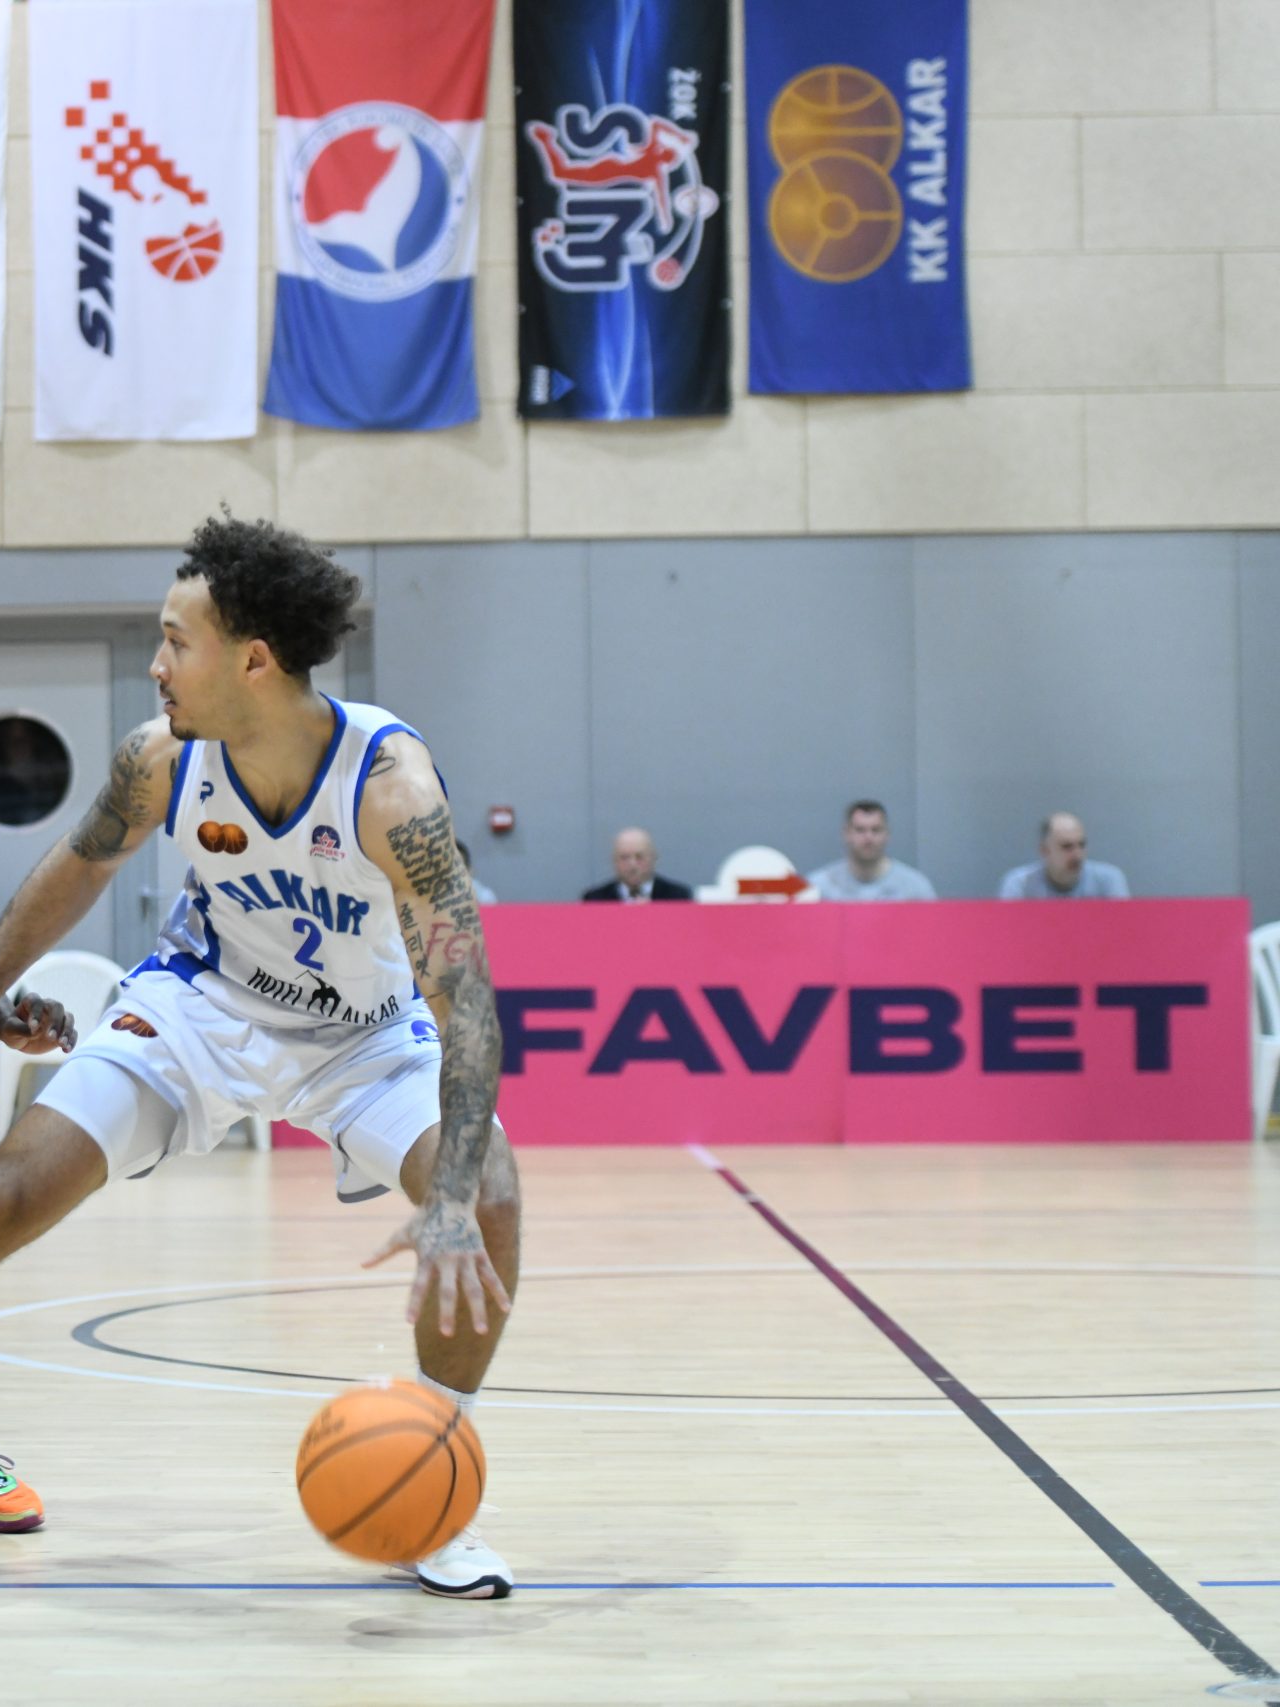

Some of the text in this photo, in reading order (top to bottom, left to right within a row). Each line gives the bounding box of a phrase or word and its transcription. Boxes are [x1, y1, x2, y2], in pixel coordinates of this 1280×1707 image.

[669, 66, 701, 120] ŽOK
[905, 57, 948, 283] KK ALKAR
[78, 187, 114, 358] HKS
[215, 869, 370, 936] ALKAR
[292, 917, 324, 971] 2
[493, 983, 1209, 1076] FAVBET
